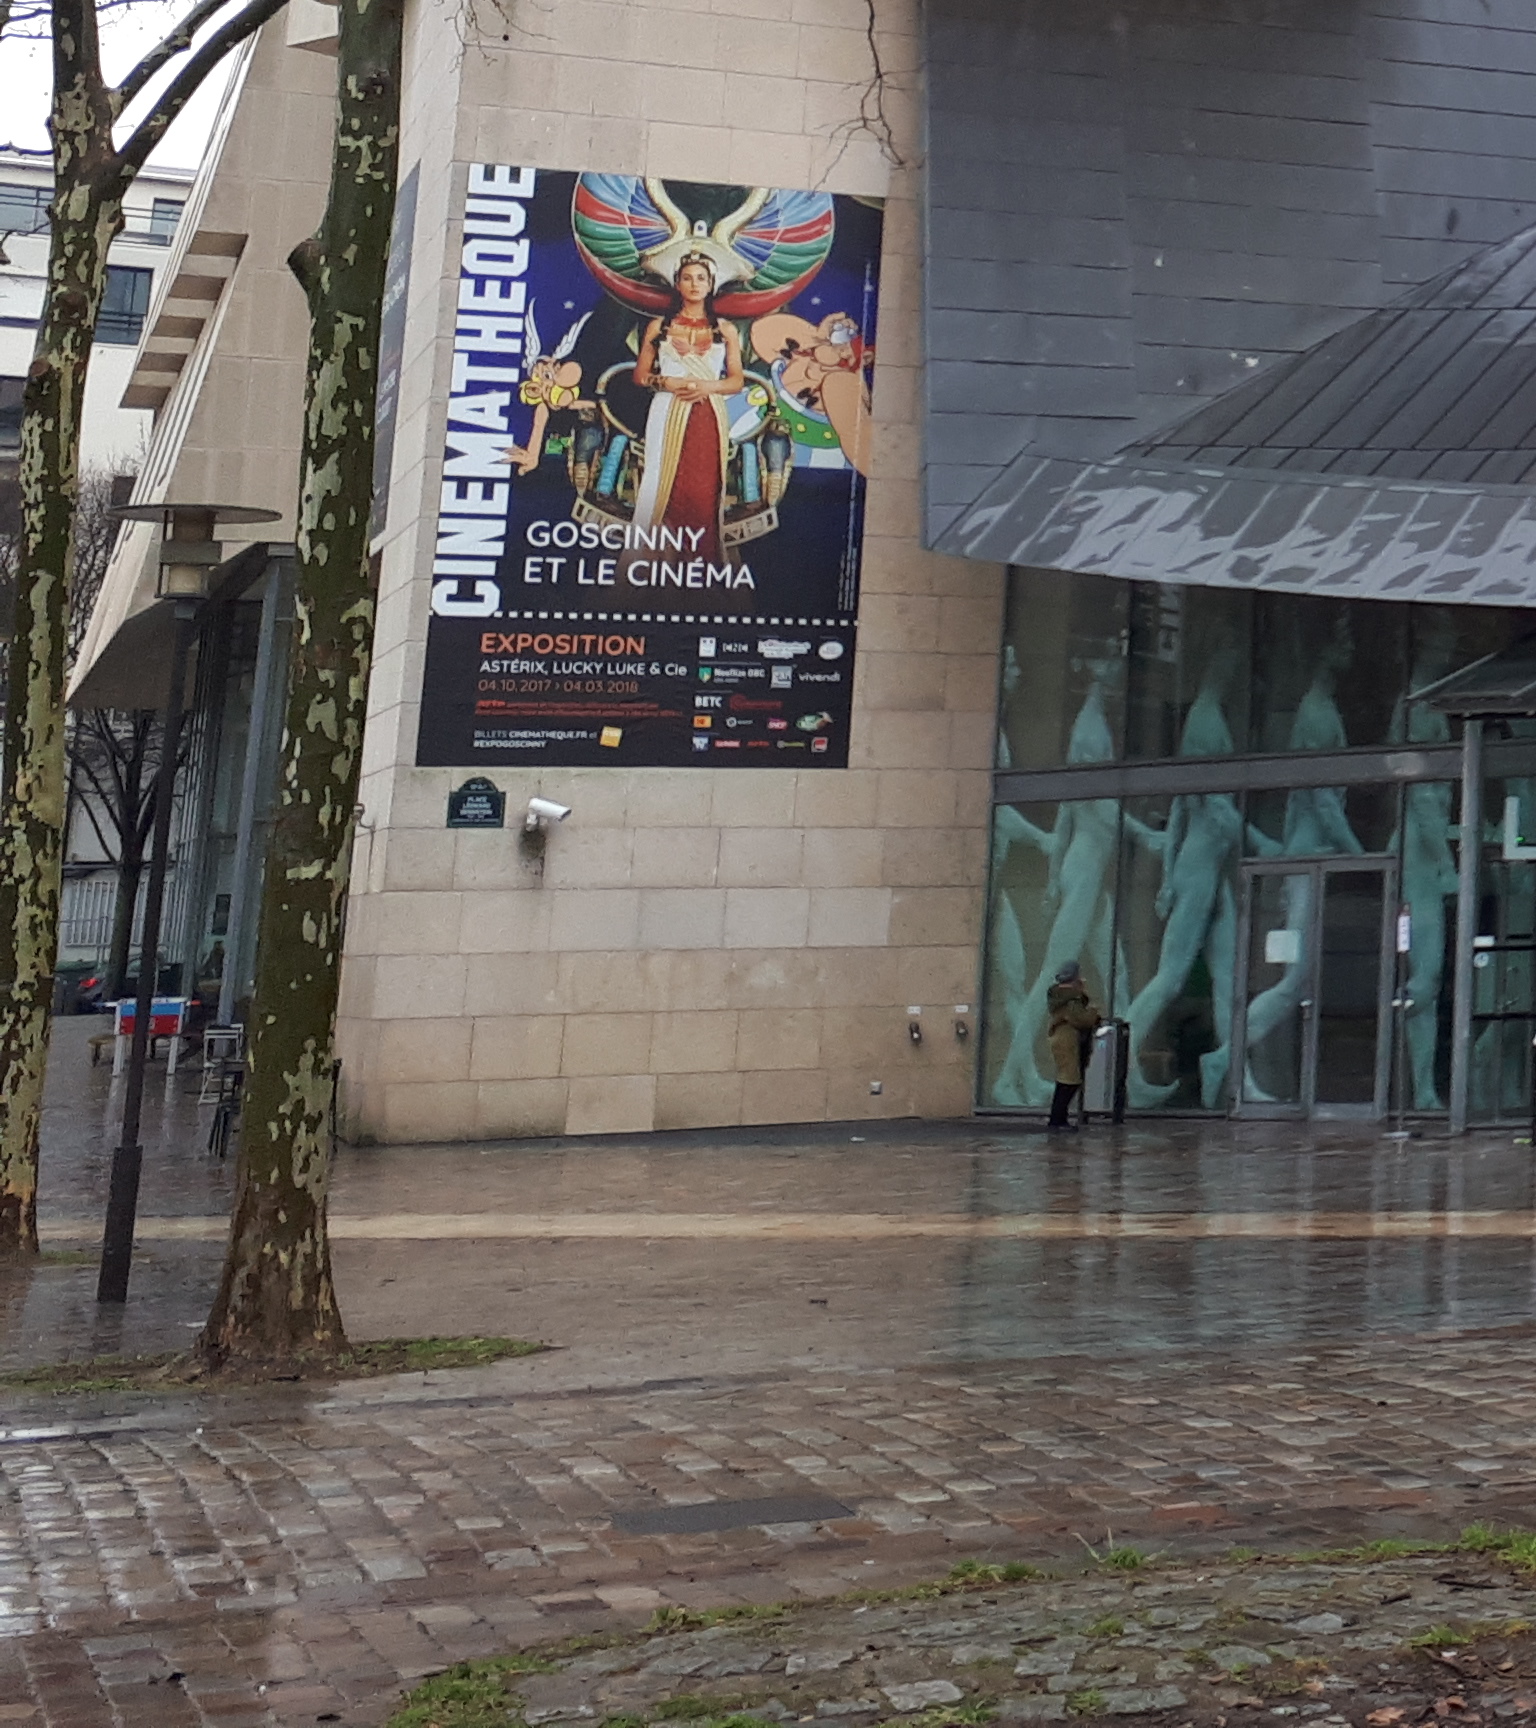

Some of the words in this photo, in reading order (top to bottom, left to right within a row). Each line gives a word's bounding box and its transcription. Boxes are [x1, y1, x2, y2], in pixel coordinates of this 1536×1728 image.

[431, 161, 536, 617] CINEMATHEQUE
[526, 520, 706, 552] GOSCINNY
[523, 556, 567, 584] ET
[577, 558, 617, 586] LE
[627, 556, 755, 589] CINÉMA
[480, 632, 646, 656] EXPOSITION
[479, 658, 549, 676] ASTÉRIX,
[553, 661, 604, 675] LUCKY
[606, 662, 646, 676] LUKE
[649, 662, 661, 676] &
[664, 662, 688, 677] Cie
[694, 695, 723, 708] BETC
